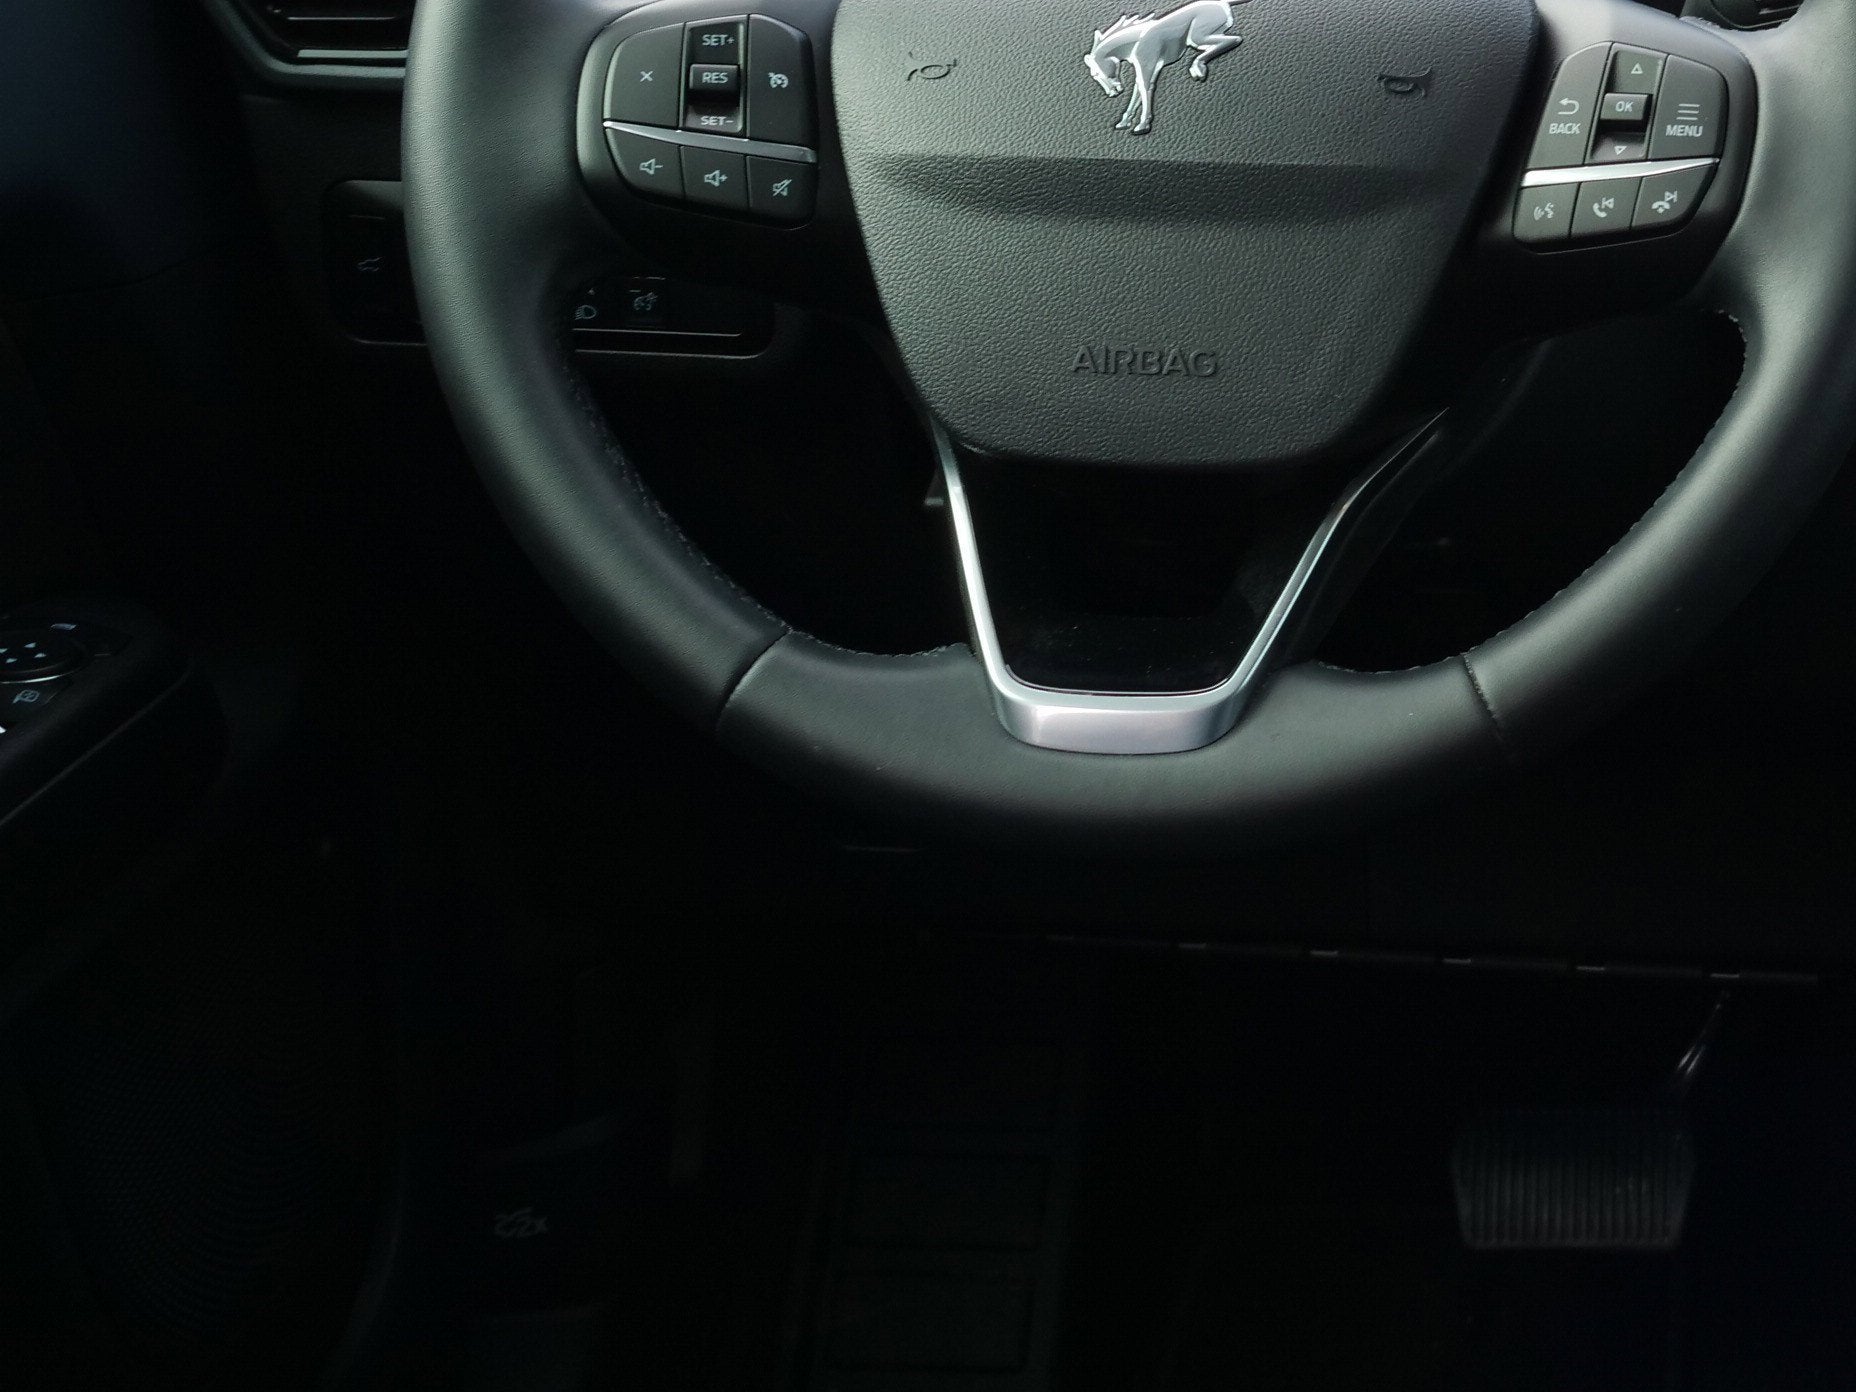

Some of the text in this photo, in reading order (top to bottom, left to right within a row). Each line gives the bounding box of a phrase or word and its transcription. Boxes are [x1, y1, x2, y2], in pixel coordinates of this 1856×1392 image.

[702, 35, 735, 46] SET+
[702, 72, 728, 84] RES
[1615, 101, 1634, 113] OK
[700, 116, 733, 126] SET-
[1549, 123, 1581, 135] BACK
[1666, 125, 1703, 137] MENU
[1072, 345, 1218, 378] AIRBAG
